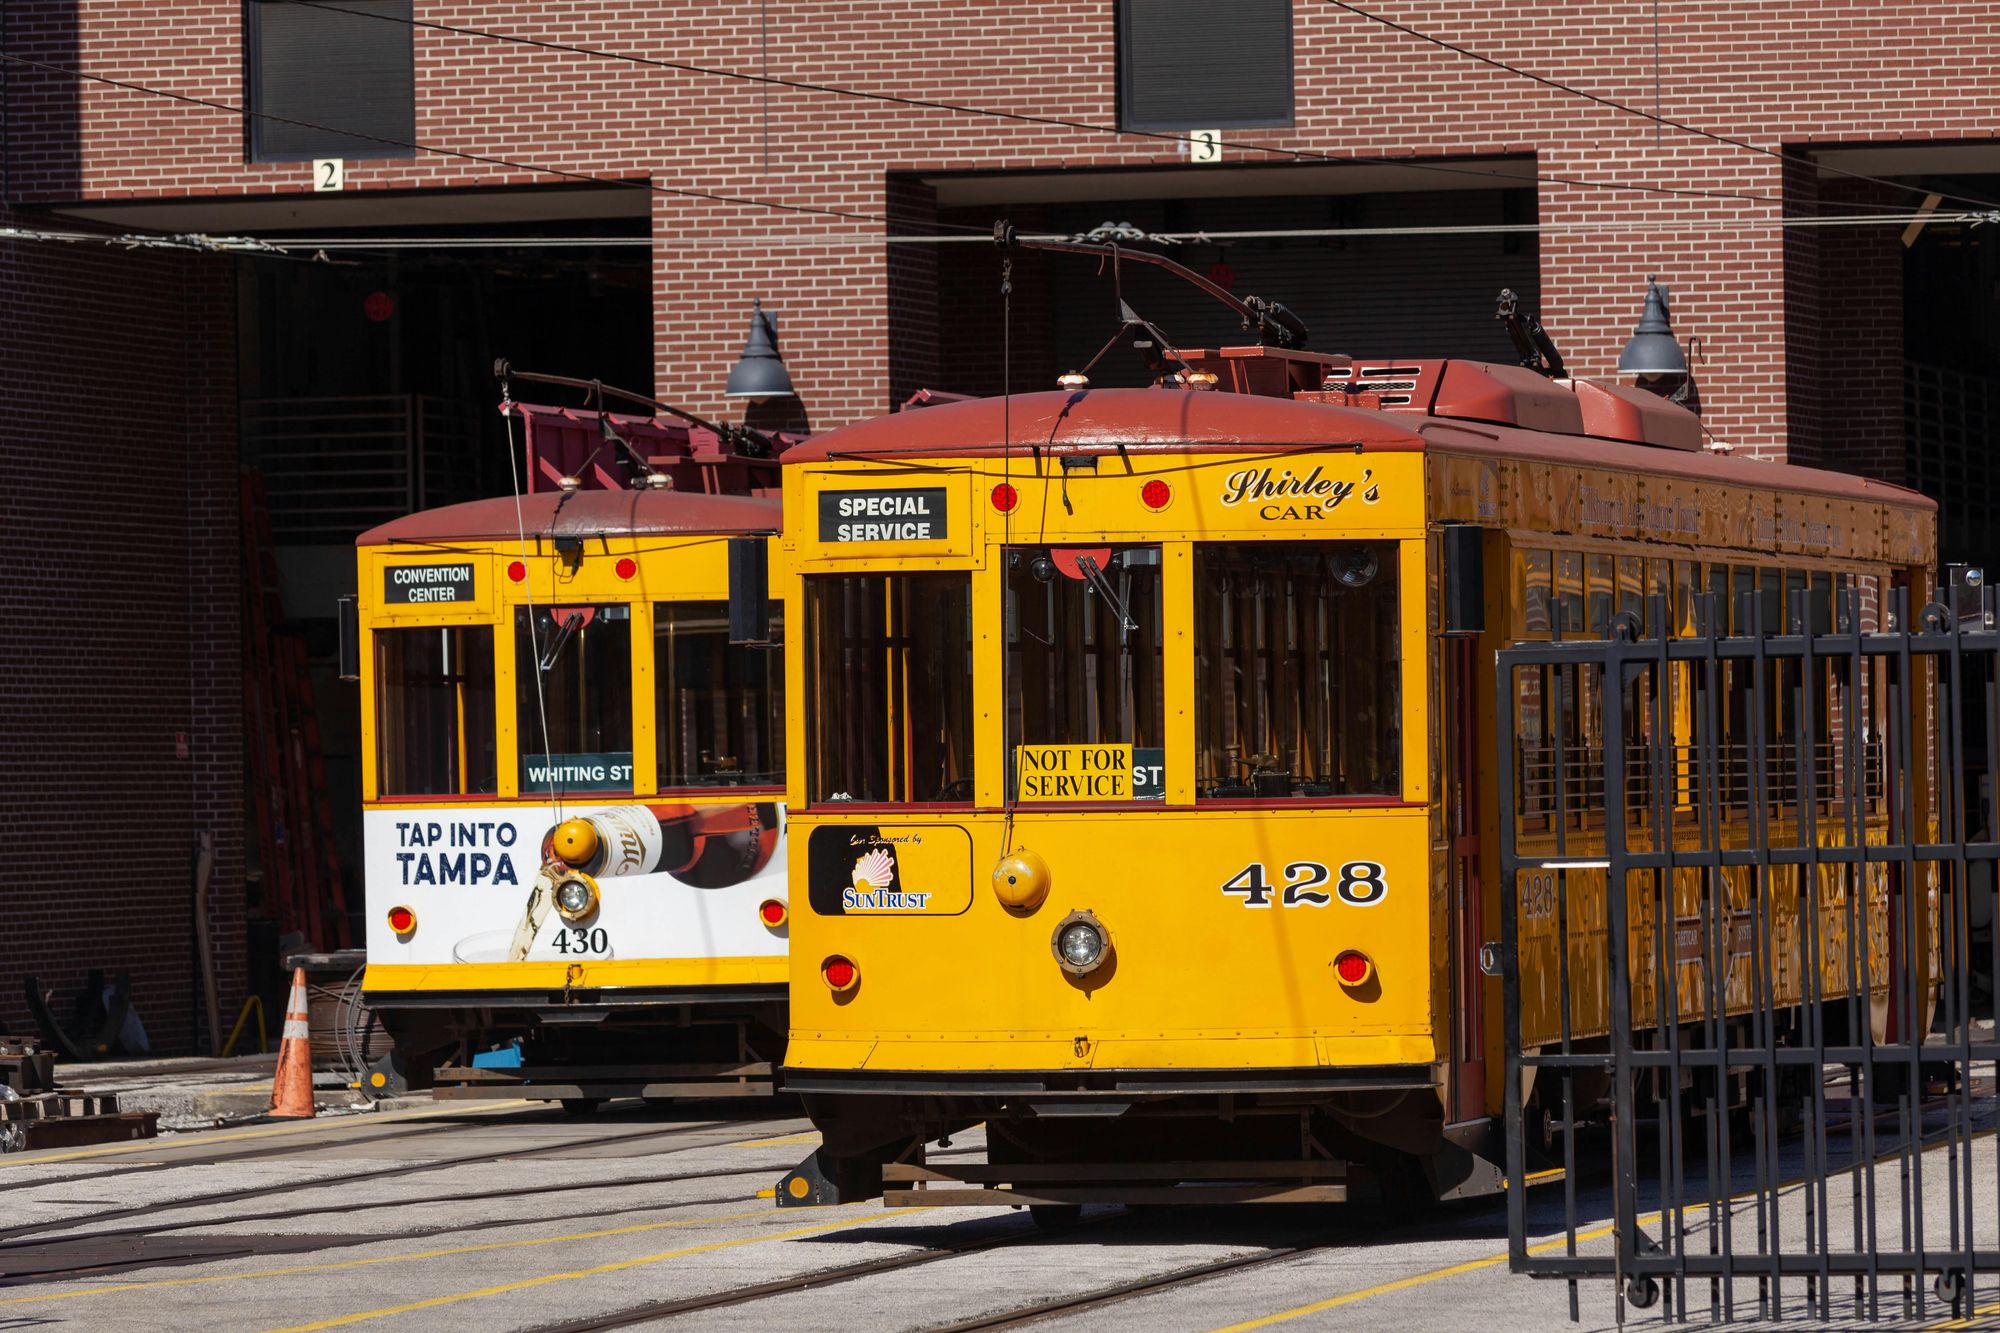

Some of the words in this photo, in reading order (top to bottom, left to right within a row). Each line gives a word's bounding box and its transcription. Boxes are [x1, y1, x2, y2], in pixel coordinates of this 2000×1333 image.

[1199, 132, 1215, 160] 3
[320, 162, 336, 188] 2
[1221, 465, 1380, 510] Shirley's
[839, 496, 930, 517] SPECIAL
[1259, 505, 1326, 520] CAR
[837, 522, 931, 542] SERVICE
[394, 566, 469, 584] CONVENTION
[408, 586, 455, 602] CENTER
[1024, 750, 1071, 771] NOT
[1081, 749, 1126, 771] FOR
[528, 766, 605, 783] WHITING
[610, 765, 632, 781] ST
[1132, 766, 1163, 786] ST
[1025, 775, 1125, 796] SERVICE
[396, 822, 442, 847] TAP
[450, 822, 517, 847] INTO
[912, 834, 923, 845] by
[396, 852, 519, 885] TAMPA
[1221, 860, 1388, 908] 428
[1522, 874, 1554, 918] 428
[552, 927, 608, 954] 430
